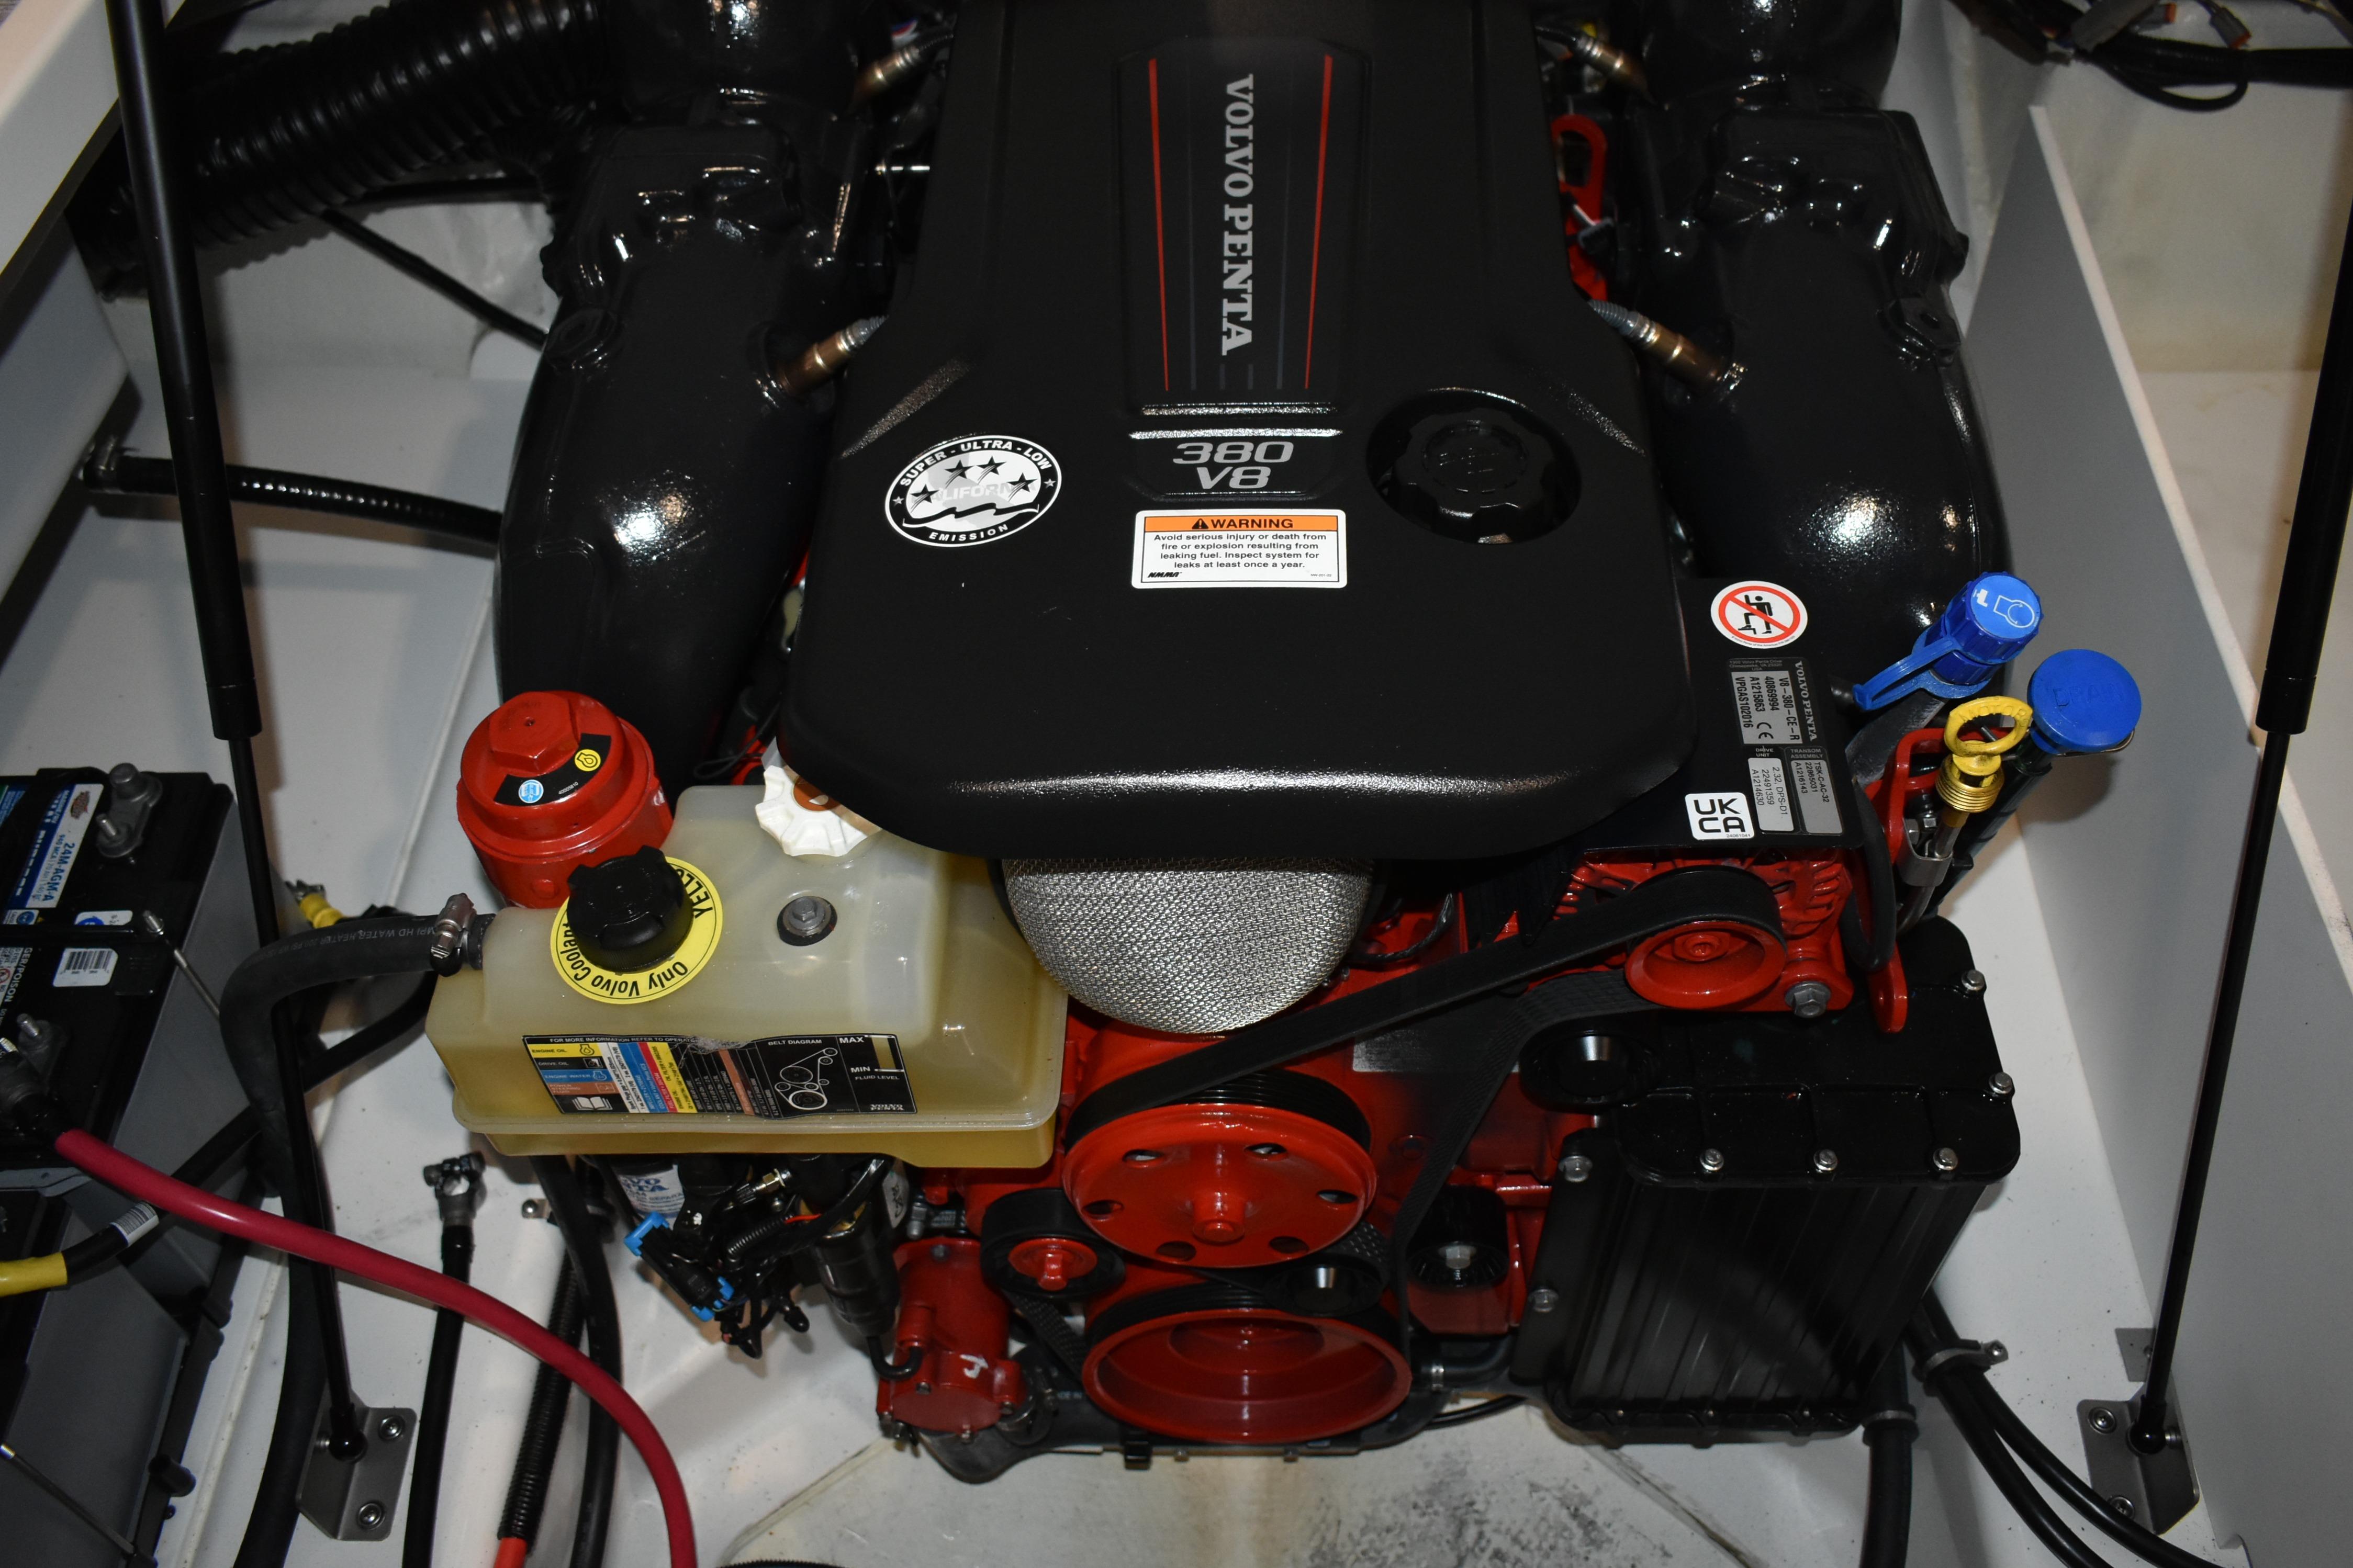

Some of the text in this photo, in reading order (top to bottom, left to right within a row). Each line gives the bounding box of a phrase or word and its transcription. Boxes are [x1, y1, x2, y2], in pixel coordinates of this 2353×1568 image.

[1222, 73, 1254, 356] VOLVO PENTA
[900, 451, 947, 487] SUPER
[960, 440, 1013, 452] ULTRA
[1023, 447, 1052, 470] LOW
[1173, 441, 1294, 464] 380
[1196, 466, 1271, 490] V8
[928, 524, 1009, 542] EMISSION
[1211, 518, 1294, 528] WARNING
[1735, 677, 1753, 728] VPGAS102016
[1750, 676, 1765, 712] A1215863
[1764, 676, 1779, 711] 40869994
[1795, 661, 1817, 741] VOLVO PENTA
[1752, 769, 1765, 806] A1214630
[1762, 769, 1774, 805] 22491359
[1814, 762, 1829, 803] TSK-C-AC-32
[1694, 798, 1741, 815] UK
[1698, 817, 1745, 833] CA
[42, 843, 75, 901] 24M-AGM-A
[676, 868, 713, 919] YELL
[320, 933, 355, 944] HEATER
[359, 929, 396, 940] WATER
[4, 947, 33, 1002] GER/POISON
[591, 975, 640, 997] Volvo
[648, 962, 688, 990] Only
